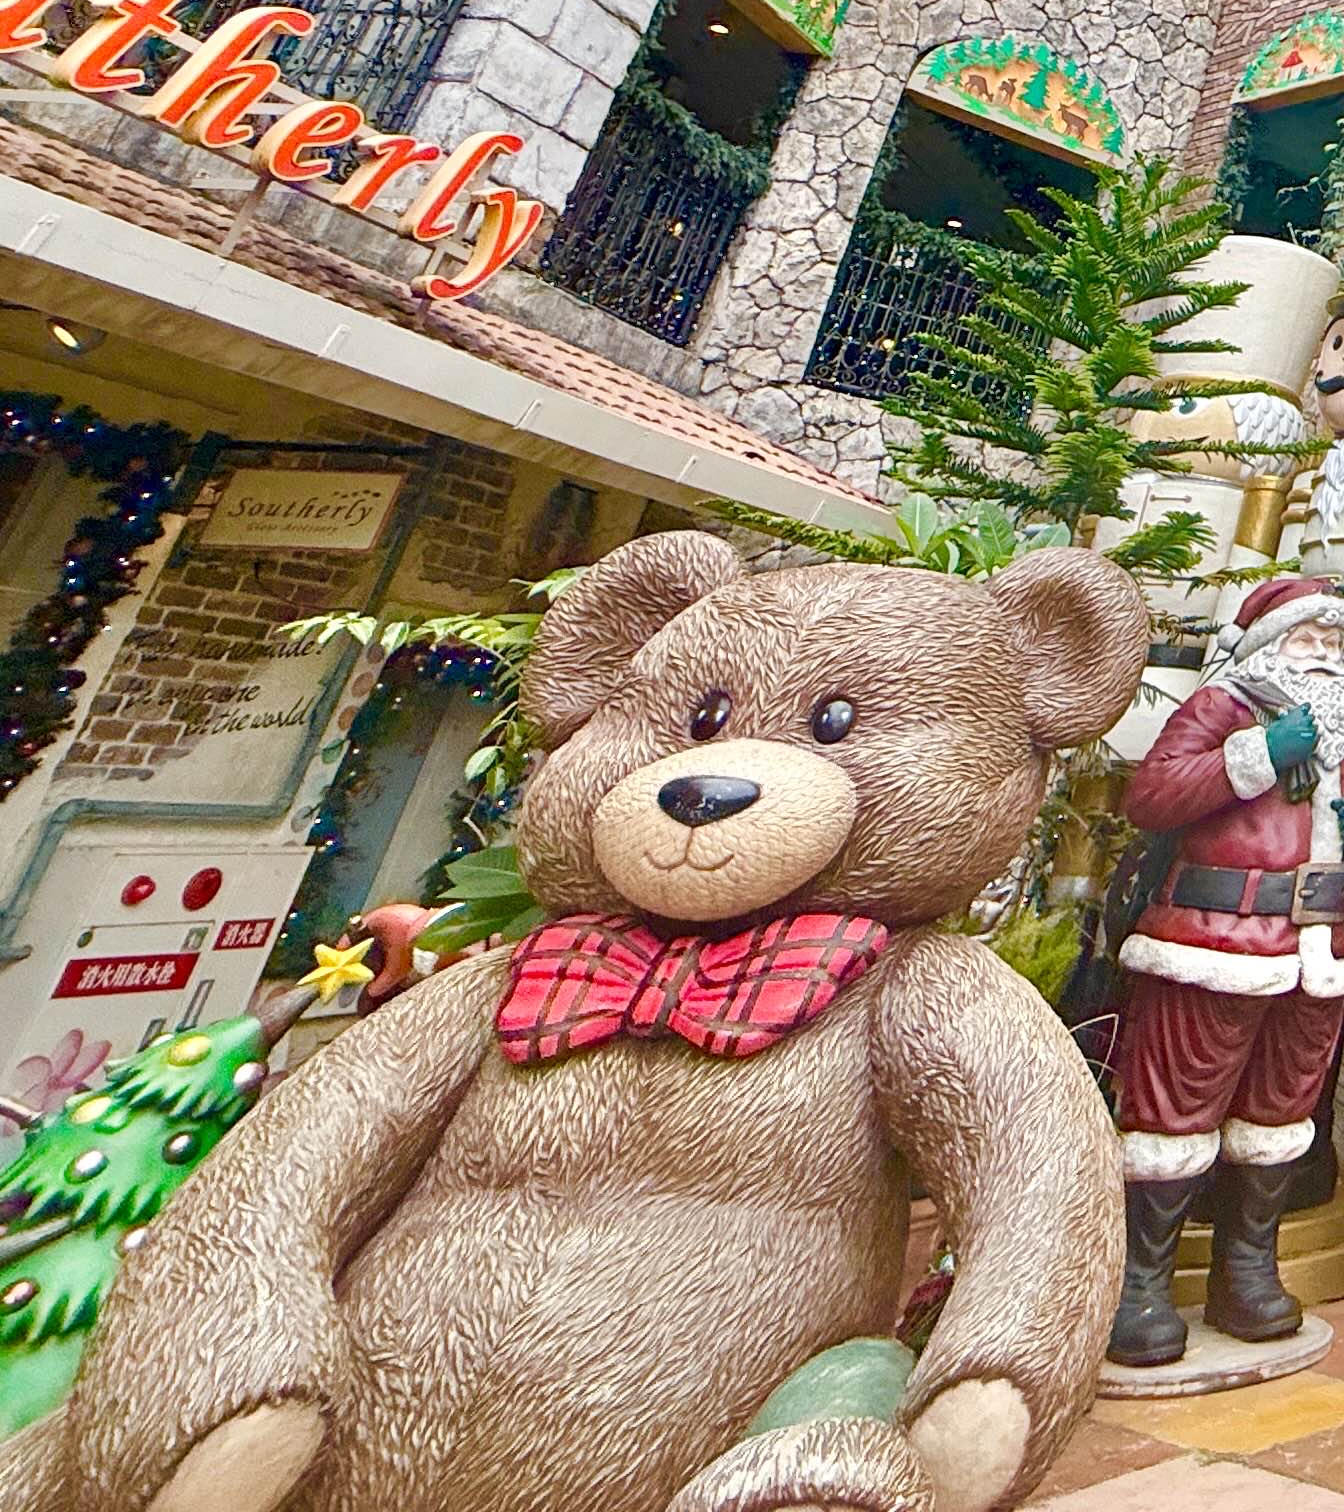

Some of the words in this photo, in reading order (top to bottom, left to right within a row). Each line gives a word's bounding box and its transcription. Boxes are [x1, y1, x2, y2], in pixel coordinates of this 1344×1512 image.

[227, 496, 374, 527] Southerly
[249, 696, 317, 729] world
[221, 922, 269, 947] 消火器
[76, 960, 176, 990] 消火用散水栓
